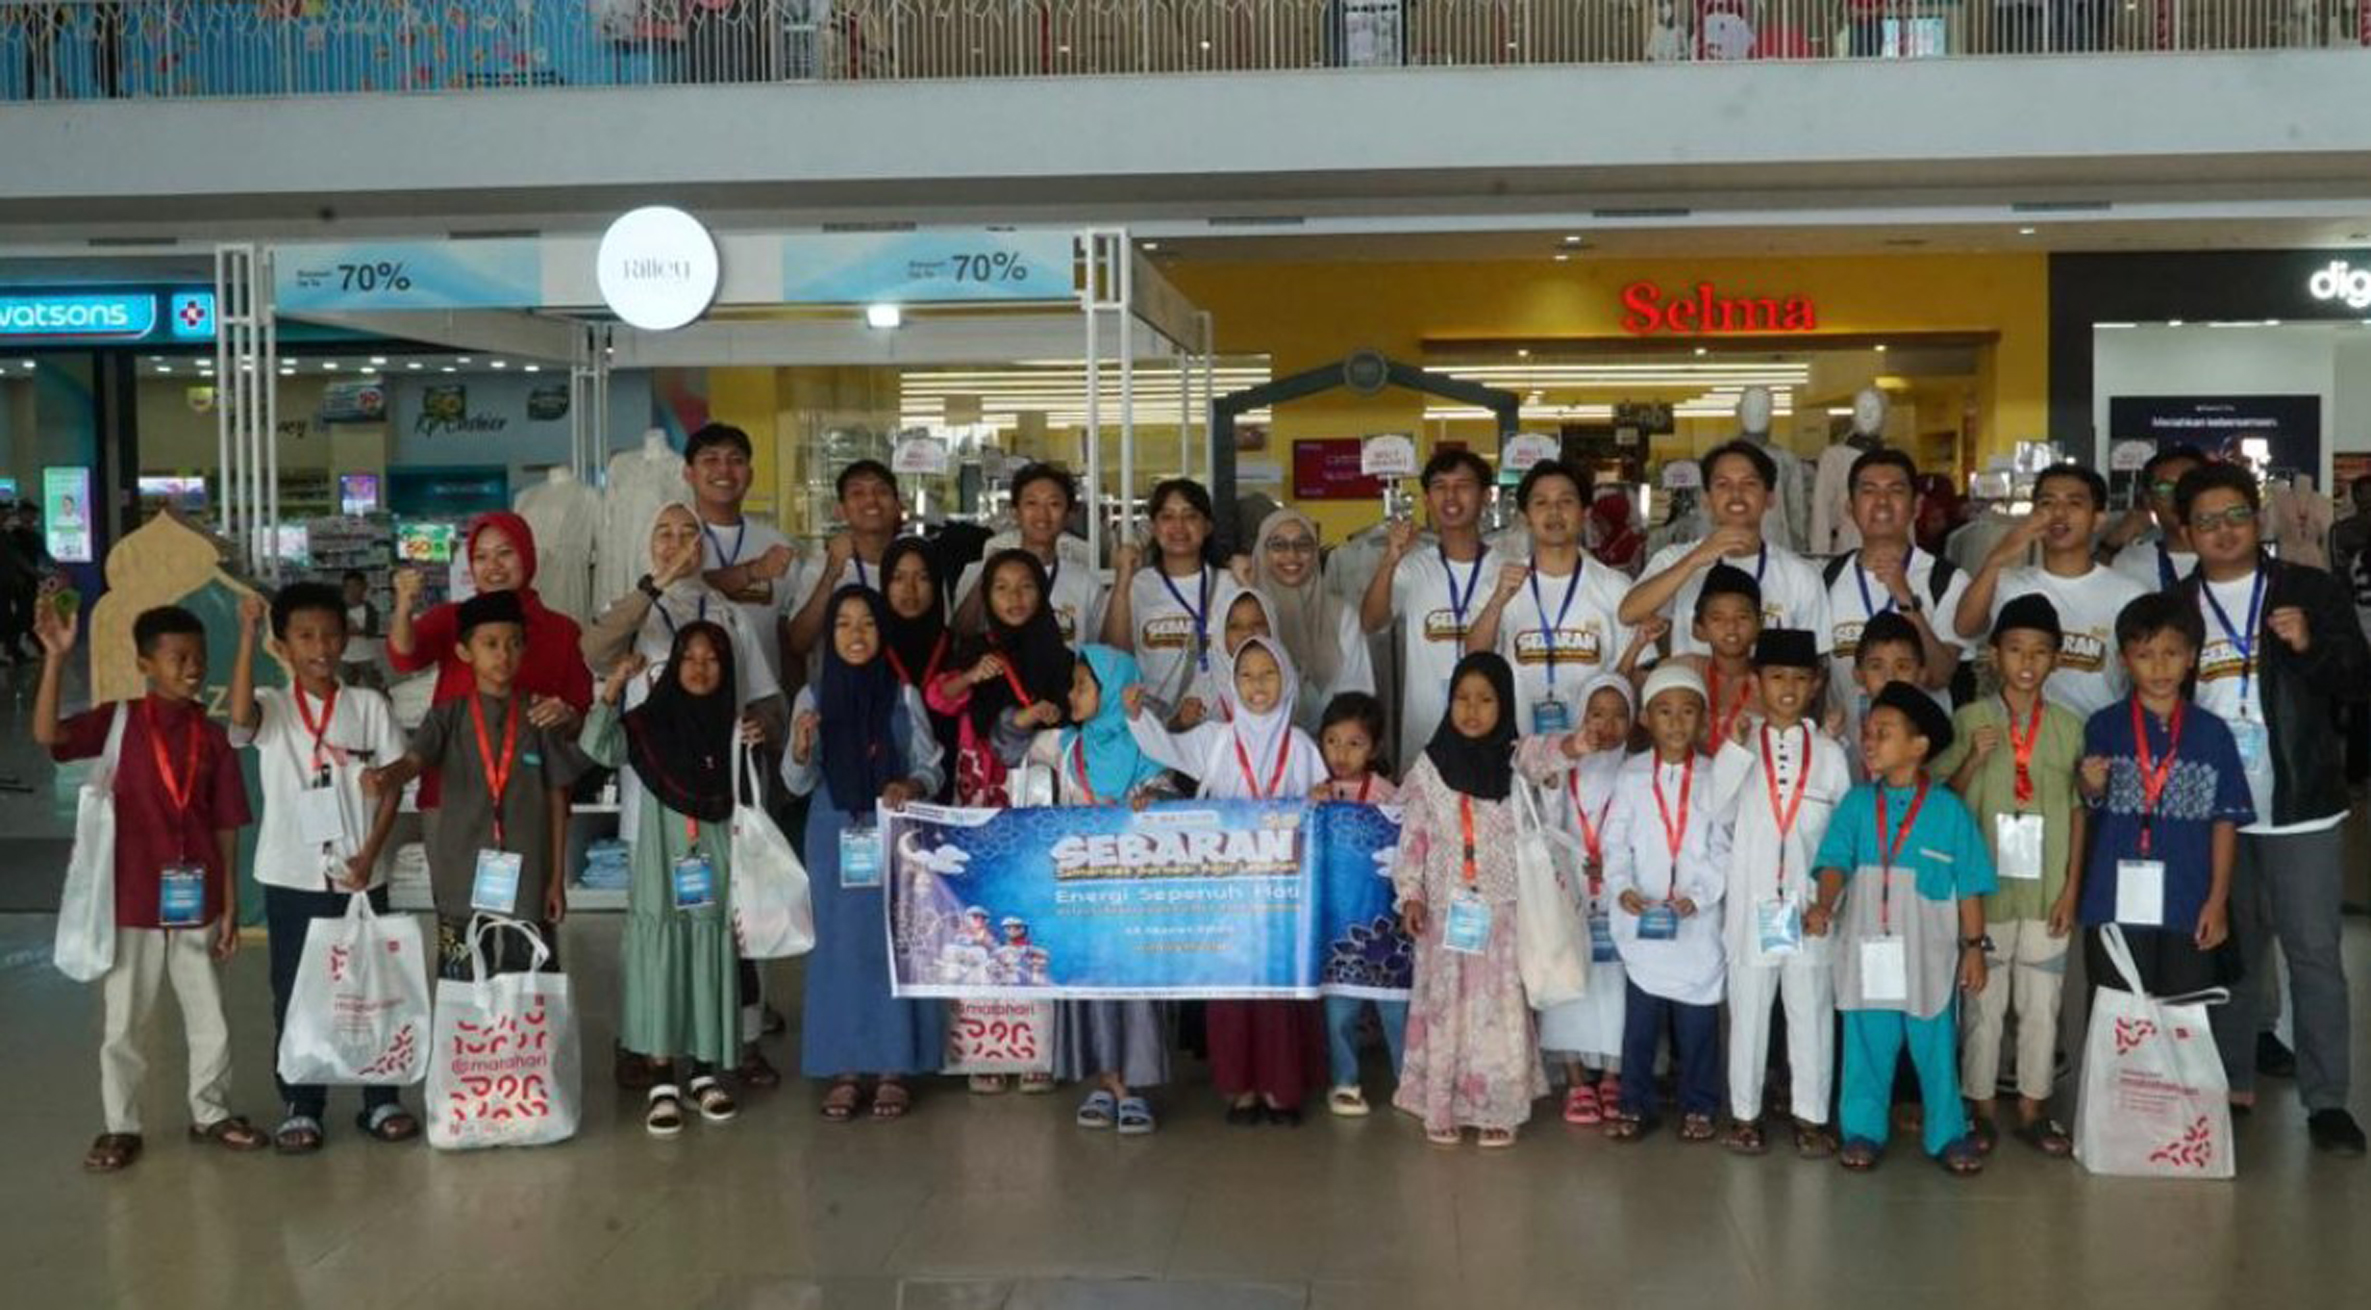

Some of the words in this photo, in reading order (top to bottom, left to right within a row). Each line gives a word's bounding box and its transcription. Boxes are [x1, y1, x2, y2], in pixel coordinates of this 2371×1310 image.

[338, 264, 411, 291] 70%
[952, 252, 1027, 282] 70%
[1622, 281, 1815, 334] Selma
[1051, 829, 1297, 869] SEBARAN
[1055, 886, 1129, 907] Energi
[1137, 883, 1244, 905] Sepenuh
[1253, 875, 1300, 900] Hati
